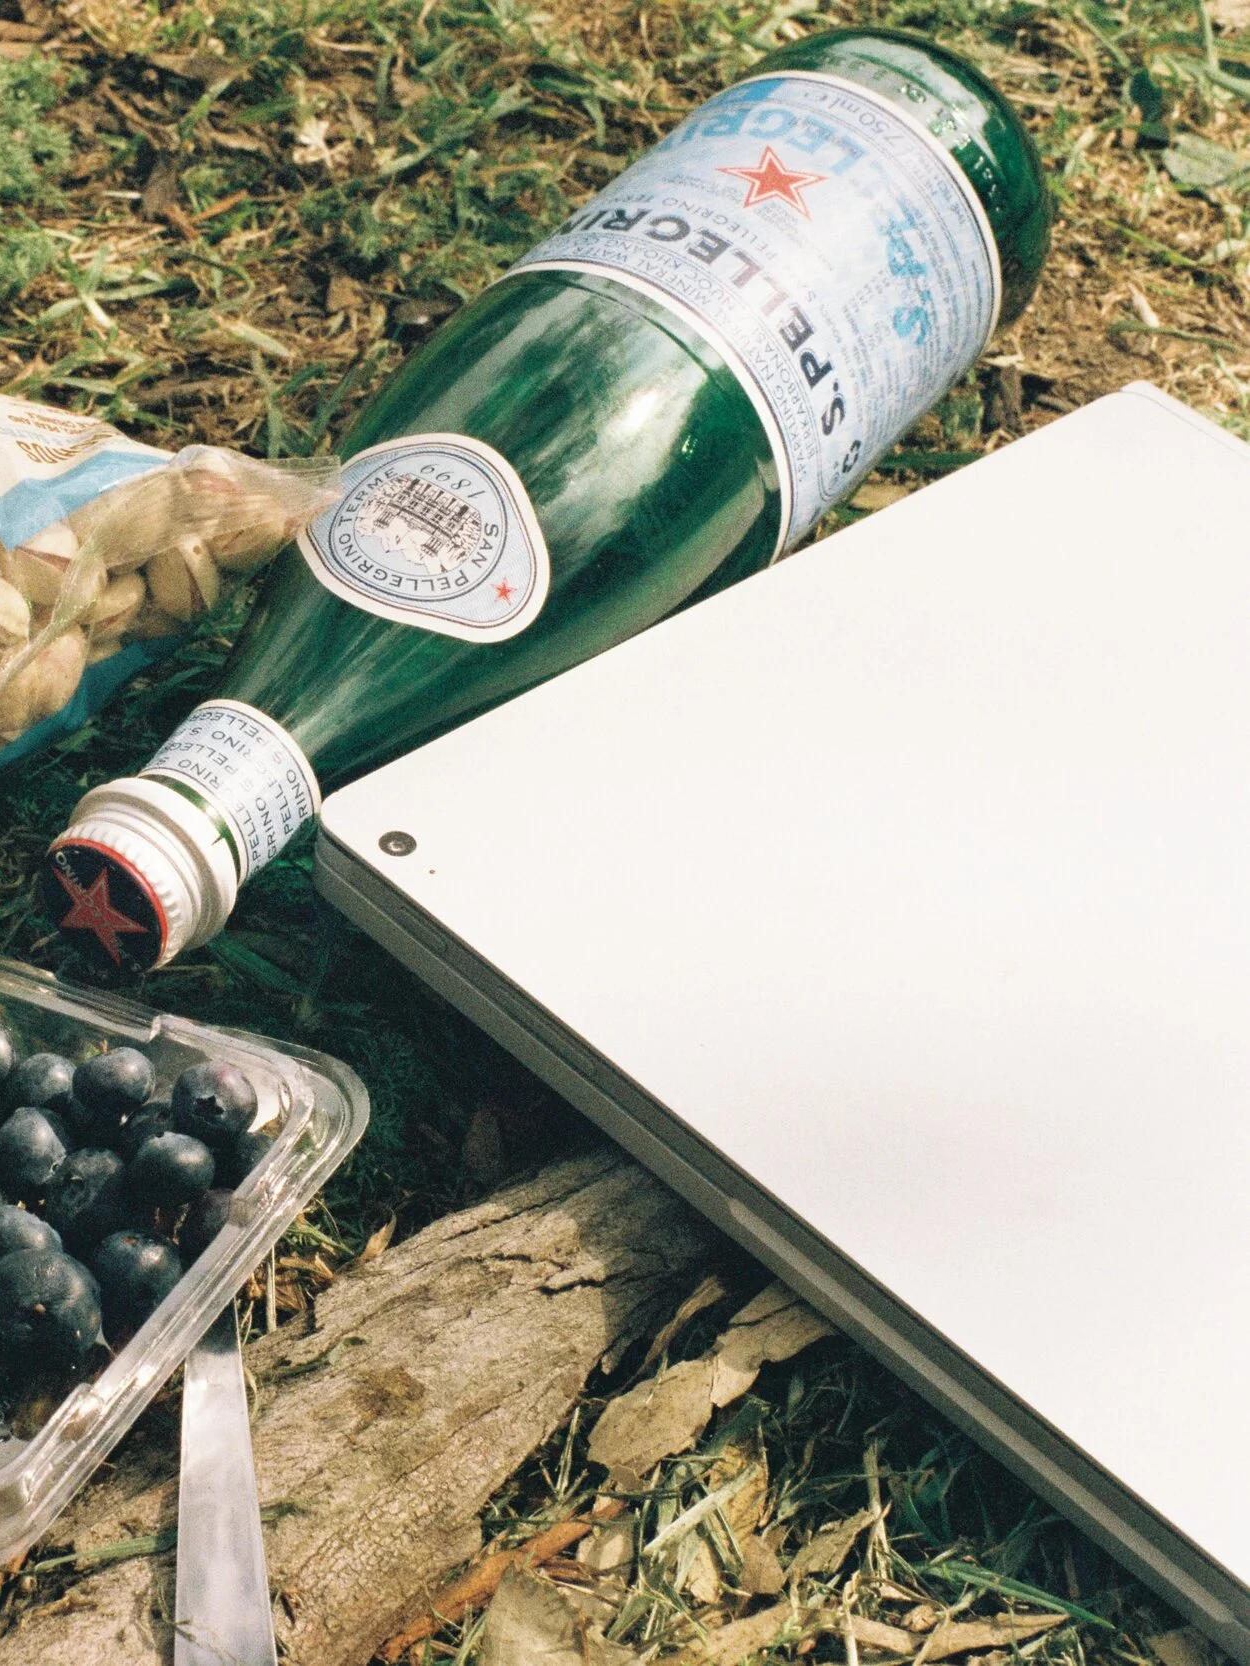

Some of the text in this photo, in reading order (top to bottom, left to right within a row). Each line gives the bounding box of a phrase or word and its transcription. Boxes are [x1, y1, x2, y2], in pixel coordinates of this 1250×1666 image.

[829, 97, 861, 115] ml
[858, 111, 904, 146] 750
[661, 196, 778, 261] PELLEGRINO
[638, 258, 710, 307] MINERAL
[552, 208, 846, 437] S.PELLEGRIN
[419, 462, 486, 499] 1899
[337, 466, 500, 592] SAN PELLEGRINO TERME
